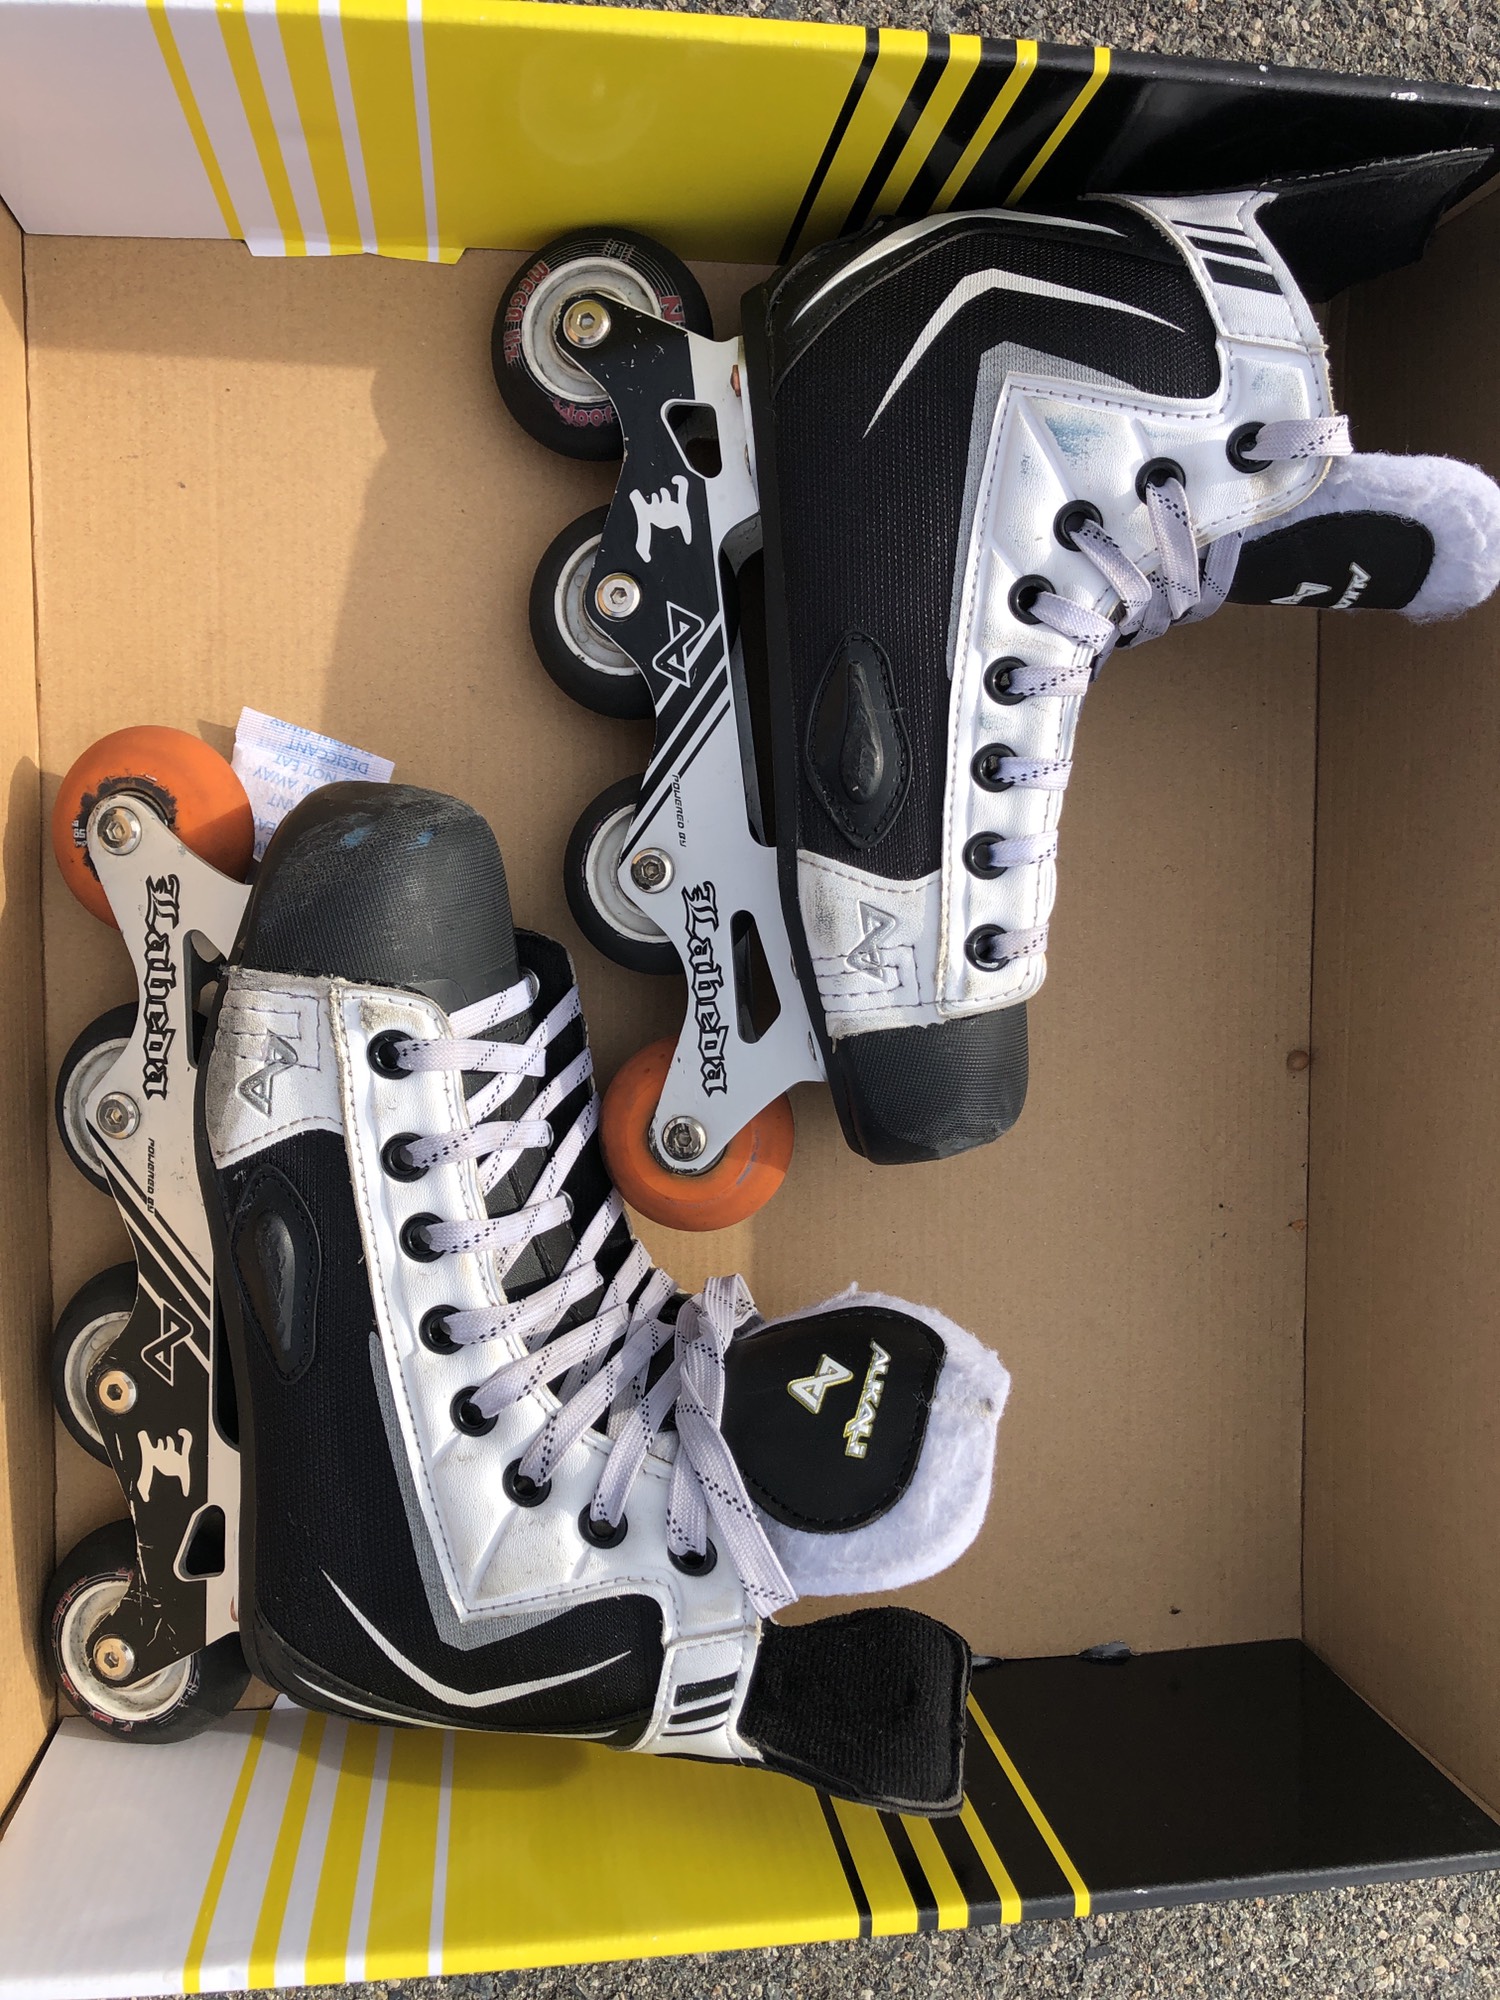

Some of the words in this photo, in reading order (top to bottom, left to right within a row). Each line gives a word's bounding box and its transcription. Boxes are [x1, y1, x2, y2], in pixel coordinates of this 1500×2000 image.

[1328, 561, 1372, 610] ALKA
[252, 765, 299, 790] AWAY
[273, 753, 300, 772] EAT
[287, 736, 370, 775] DESICCANT
[303, 765, 337, 783] NOT
[671, 774, 685, 829] POWERED
[678, 831, 688, 848] BY
[142, 873, 180, 1100] Labeda
[681, 881, 730, 1097] Labeda
[147, 1138, 156, 1193] POWERED
[843, 1338, 892, 1460] ALKALI
